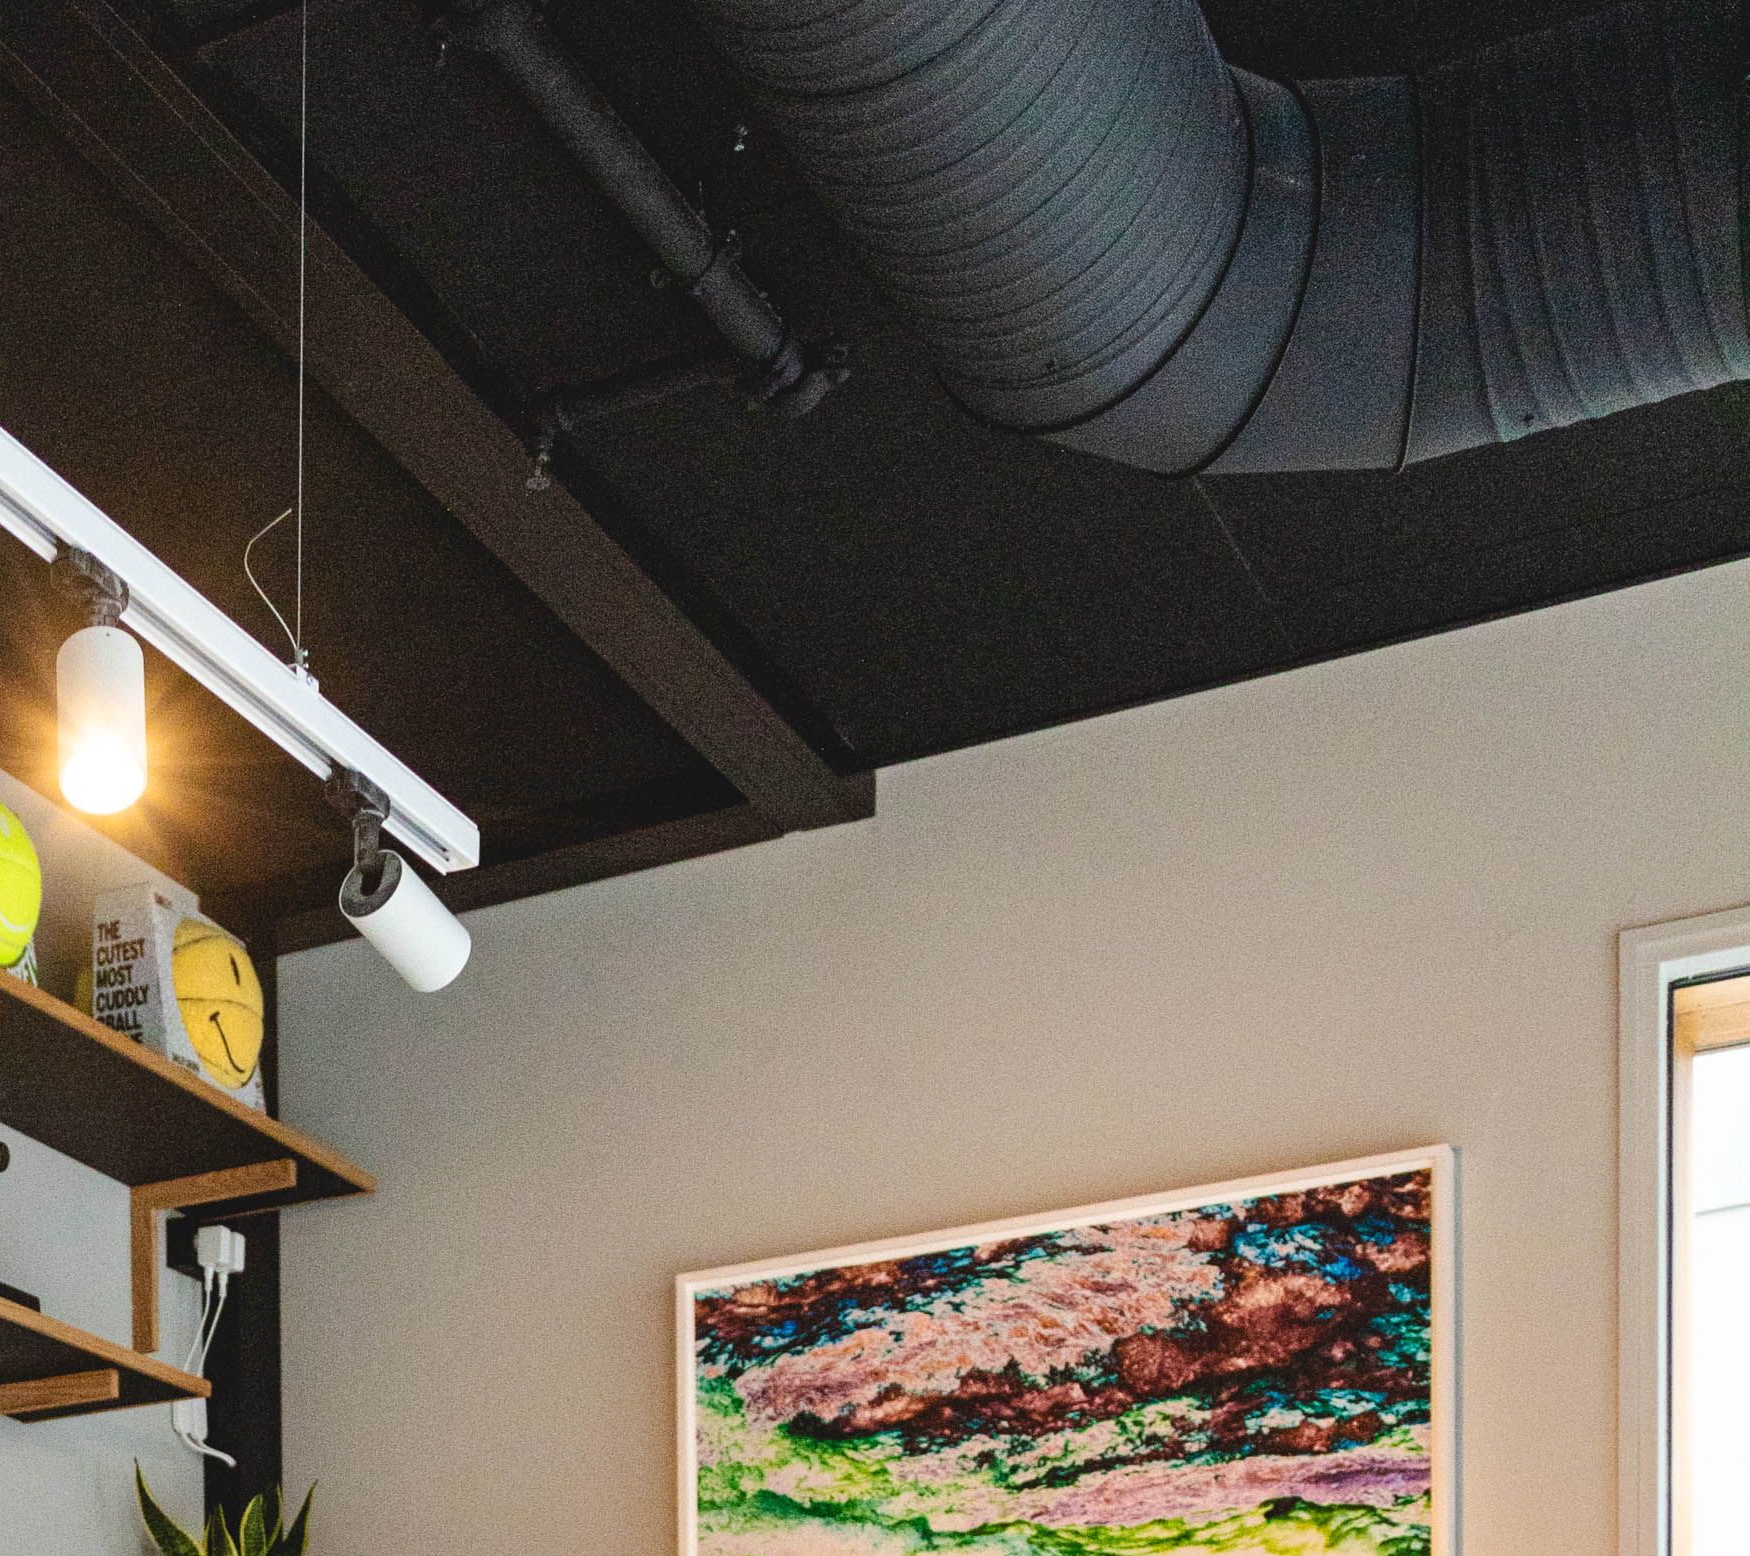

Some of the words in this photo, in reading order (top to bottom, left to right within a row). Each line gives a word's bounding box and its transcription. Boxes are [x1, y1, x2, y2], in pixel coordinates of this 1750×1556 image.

[97, 920, 121, 942] THE
[96, 939, 145, 966] CUTEST
[96, 965, 134, 989] MOST
[96, 984, 149, 1012] CUDDLY
